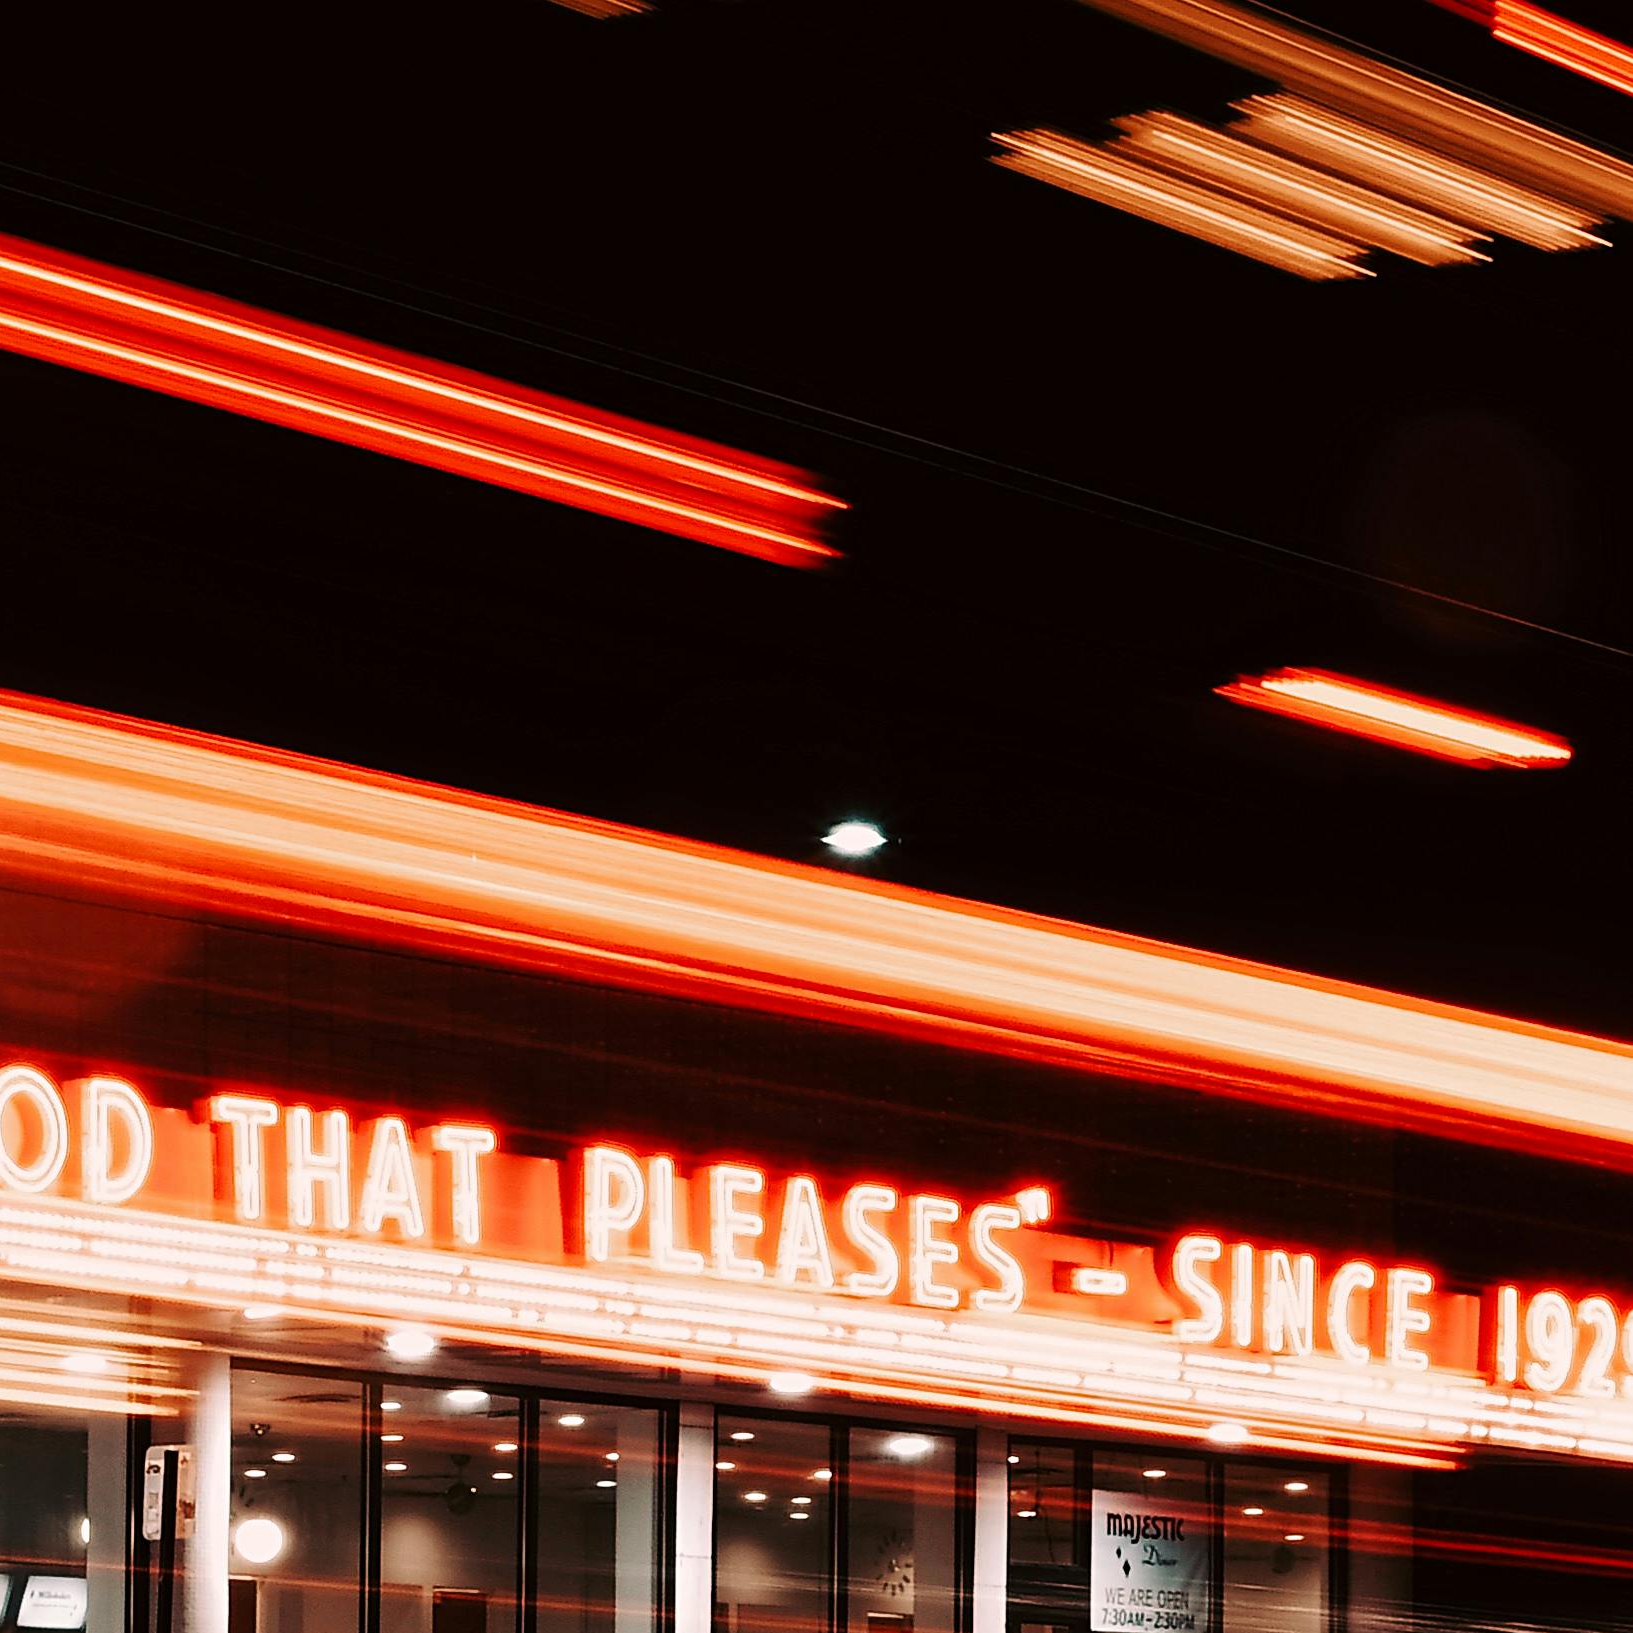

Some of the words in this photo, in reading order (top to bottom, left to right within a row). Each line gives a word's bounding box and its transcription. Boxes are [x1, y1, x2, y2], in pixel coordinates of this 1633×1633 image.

[210, 1094, 496, 1244] THAT
[1174, 1235, 1432, 1371] SINCE
[1498, 1286, 1633, 1399] 192
[1107, 1513, 1184, 1544] MAJESTIC
[1105, 1588, 1124, 1605] WE
[1128, 1588, 1153, 1607] ARE
[1157, 1590, 1189, 1609] OPEN
